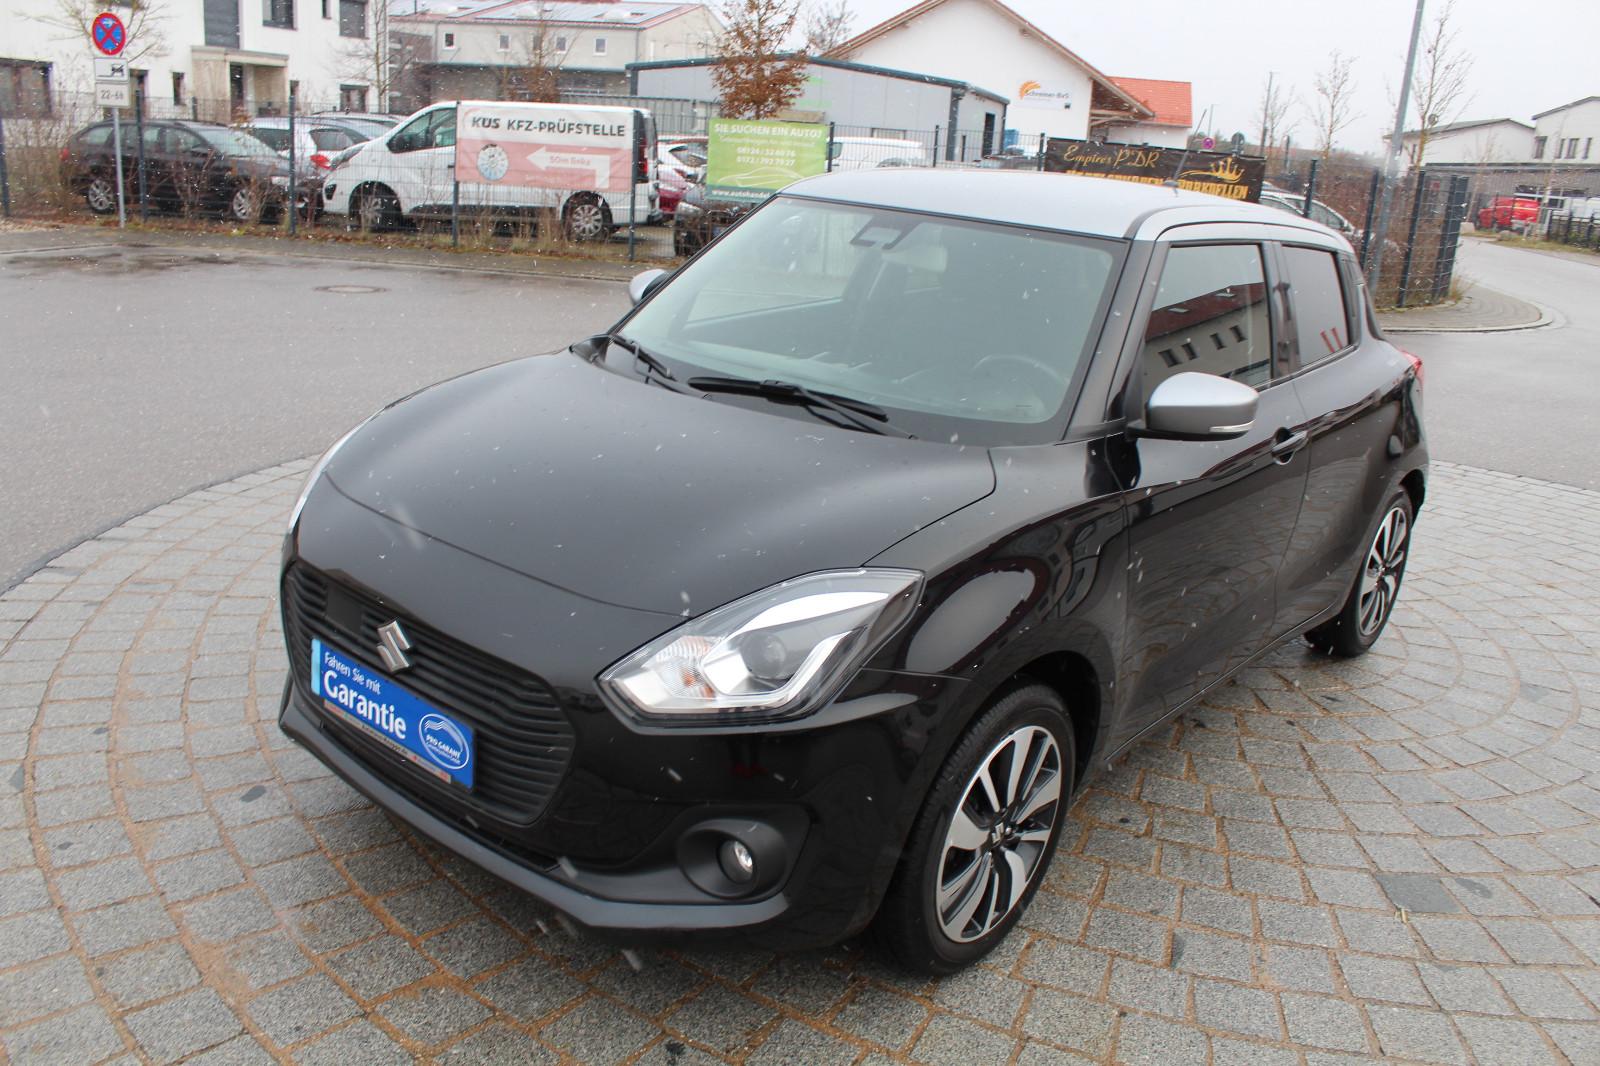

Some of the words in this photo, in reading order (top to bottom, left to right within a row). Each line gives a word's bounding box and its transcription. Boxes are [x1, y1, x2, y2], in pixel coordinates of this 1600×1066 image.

[507, 117, 625, 138] KFZ-PRÜFSTELLE
[713, 123, 729, 133] SIE
[730, 124, 770, 136] SUCHEN
[771, 126, 789, 137] EIN
[324, 651, 351, 677] Fahren
[352, 667, 365, 685] Sie
[365, 679, 381, 696] mit
[323, 669, 407, 740] Garantie
